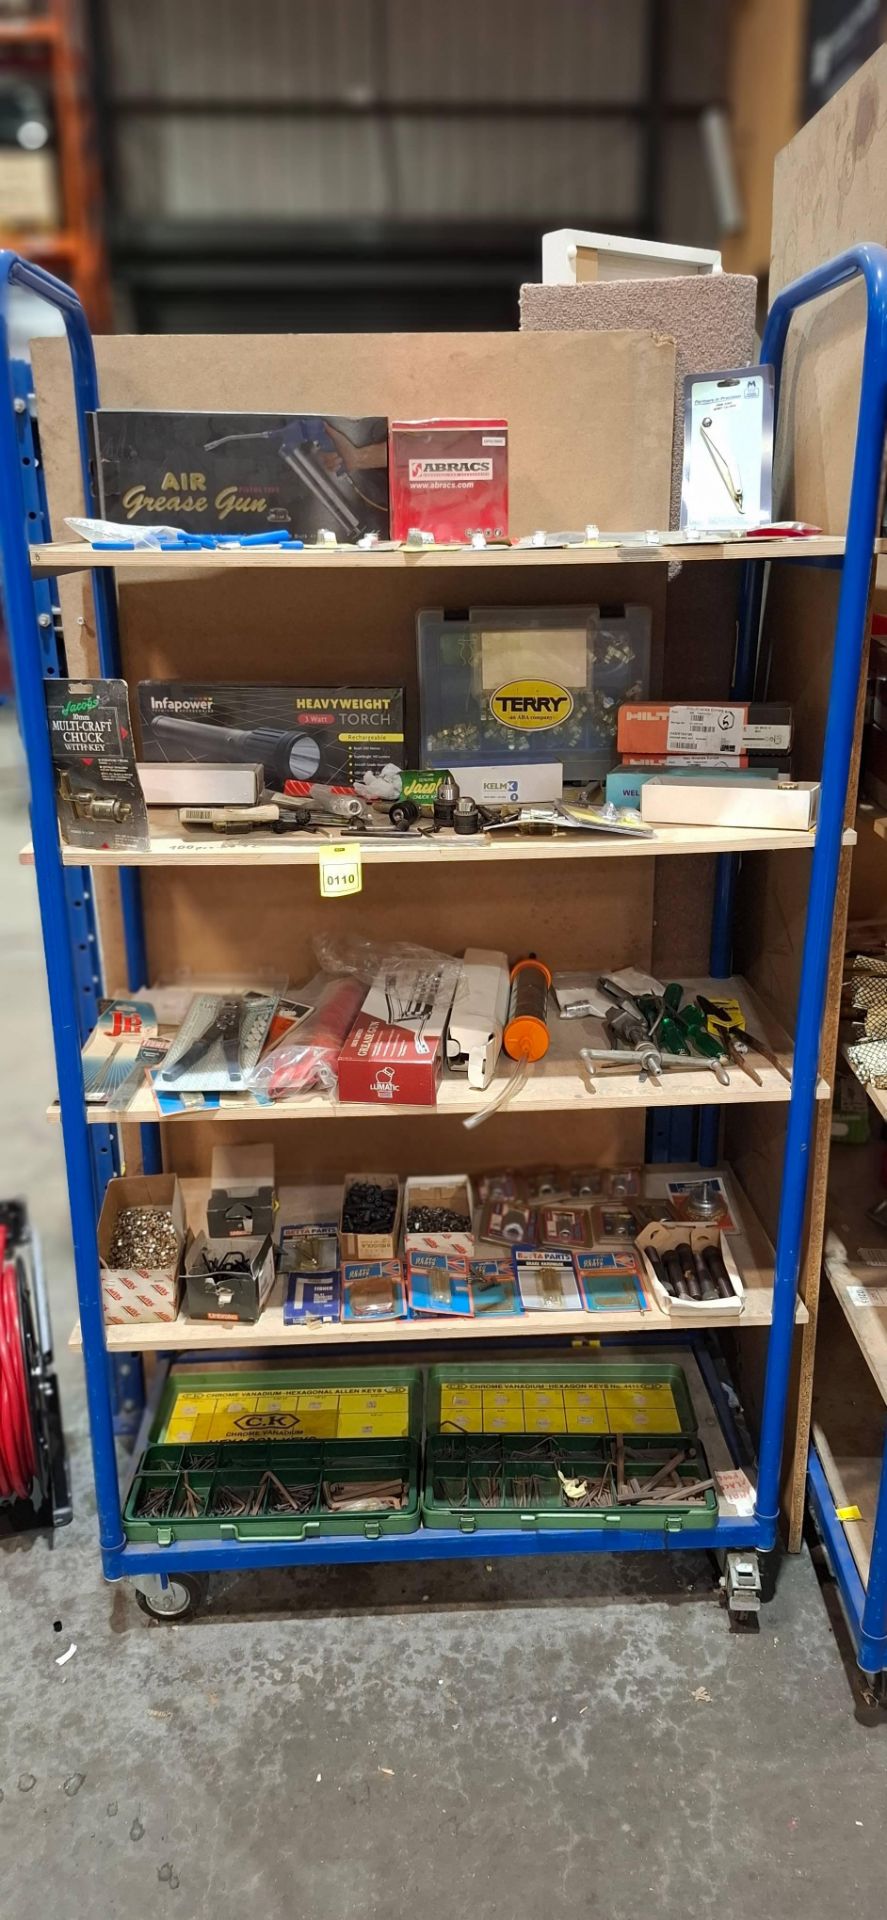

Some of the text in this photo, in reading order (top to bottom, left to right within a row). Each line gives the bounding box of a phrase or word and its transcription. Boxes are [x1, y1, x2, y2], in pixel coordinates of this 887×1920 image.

[423, 462, 490, 472] ABRACS
[161, 472, 207, 491] AIR
[409, 481, 475, 489] www.abracs.com
[122, 485, 268, 520] Grease Gun
[62, 698, 99, 717] Jacobs
[151, 696, 214, 712] Infapower
[296, 698, 391, 709] HEAVYWEIGHT
[495, 697, 568, 712] TERRY
[311, 715, 328, 723] Watt
[339, 713, 391, 725] TORCH
[52, 720, 112, 732] MULTI-CRAFT
[63, 732, 105, 743] CHUCK
[347, 734, 387, 742] Rechargeable
[64, 743, 105, 752] WITH KEY
[327, 873, 355, 886] 0110
[370, 1083, 401, 1092] LUMATIC
[544, 1253, 571, 1261] PARTS
[245, 1415, 288, 1427] C.K
